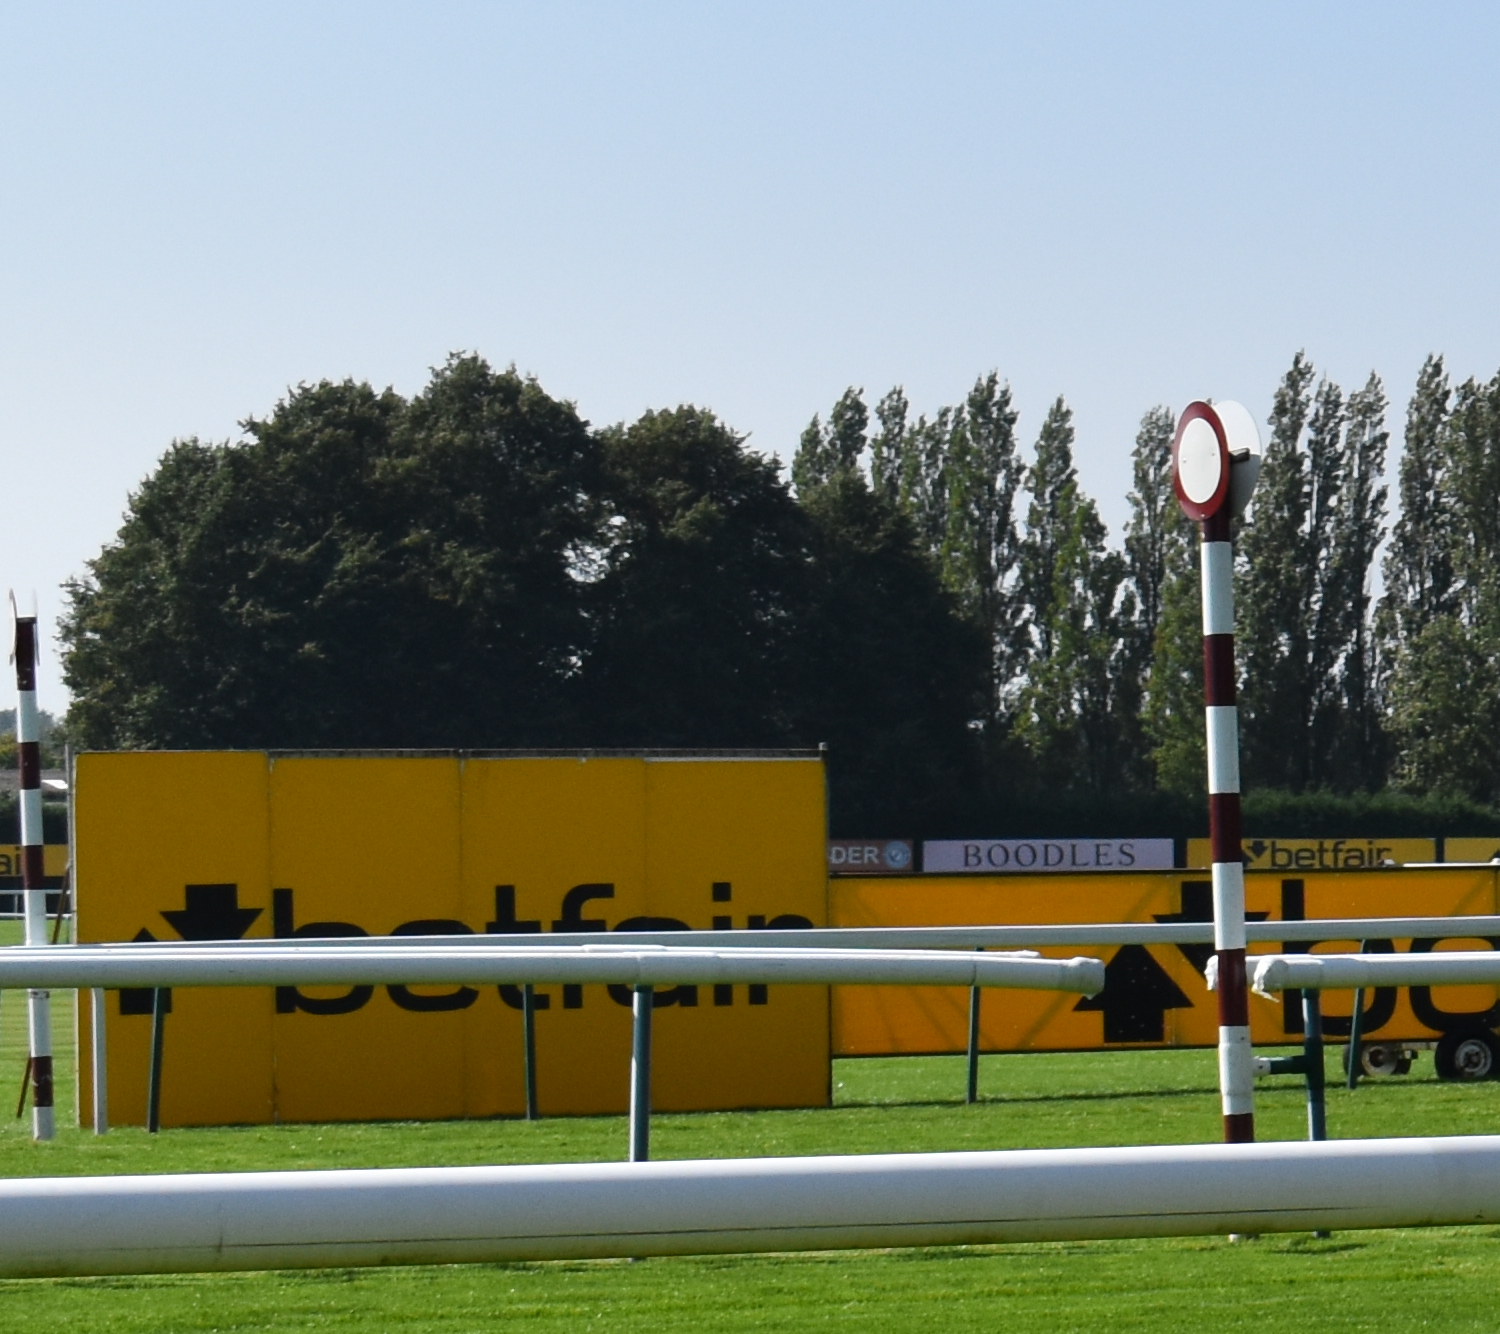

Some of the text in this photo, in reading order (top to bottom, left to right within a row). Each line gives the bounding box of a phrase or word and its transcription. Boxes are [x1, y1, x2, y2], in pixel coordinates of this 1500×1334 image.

[828, 845, 879, 864] DER
[963, 843, 1136, 867] BOODLES
[1271, 840, 1391, 867] betfair
